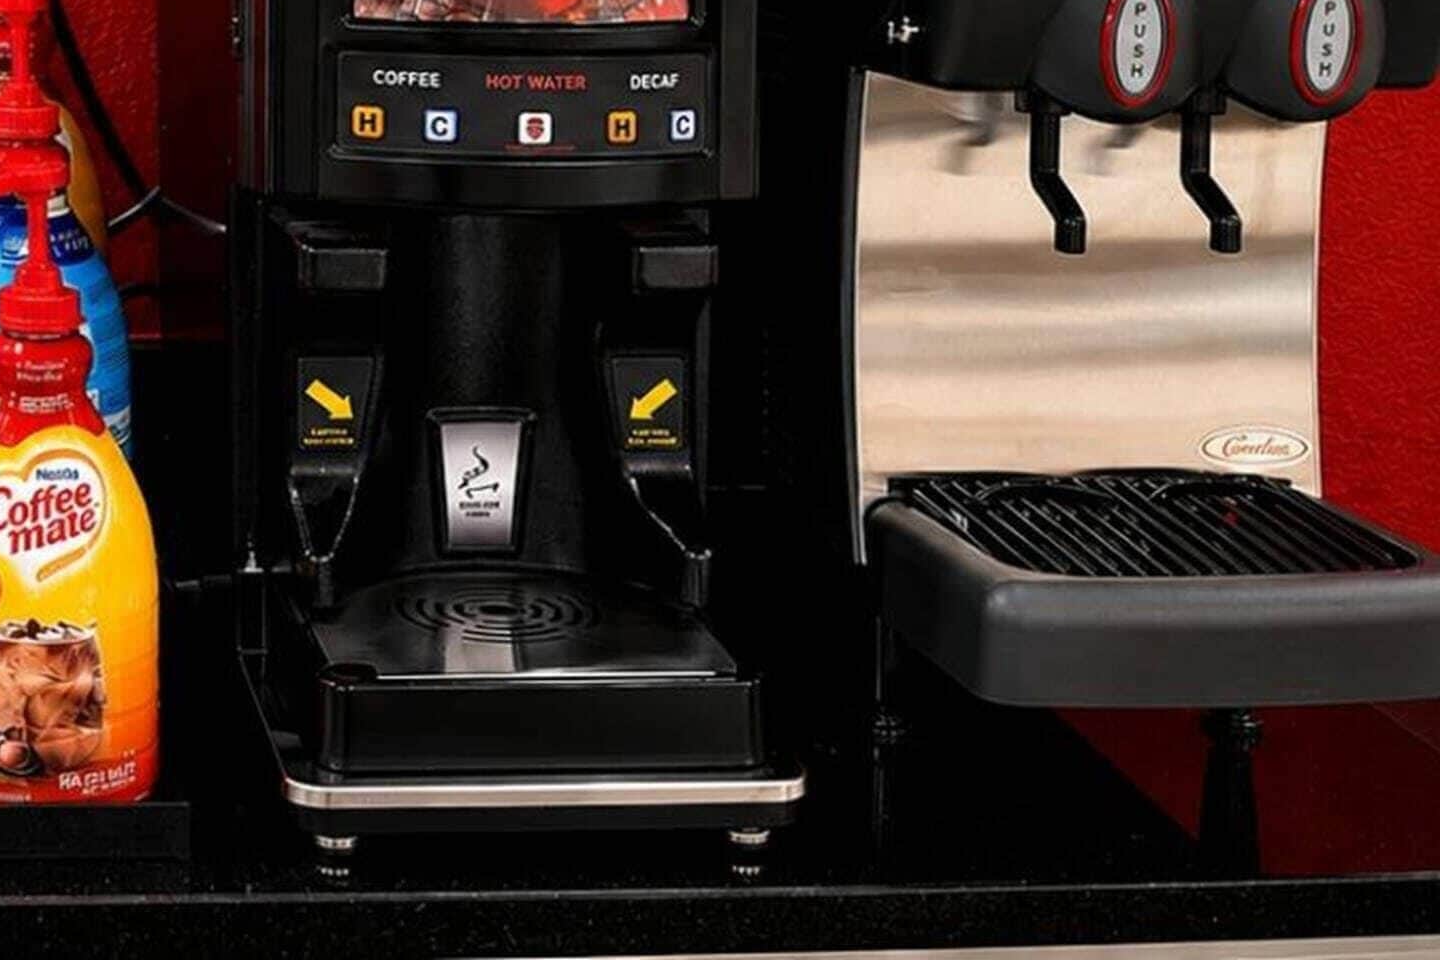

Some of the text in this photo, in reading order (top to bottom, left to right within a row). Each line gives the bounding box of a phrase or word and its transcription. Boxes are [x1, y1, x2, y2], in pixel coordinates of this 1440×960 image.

[1130, 1, 1148, 78] PUSH
[1318, 0, 1337, 77] PUSH
[372, 69, 441, 89] COFFEE
[485, 73, 523, 90] HOT
[527, 74, 587, 91] WATER
[630, 73, 680, 90] DECAF
[8, 508, 97, 555] mate
